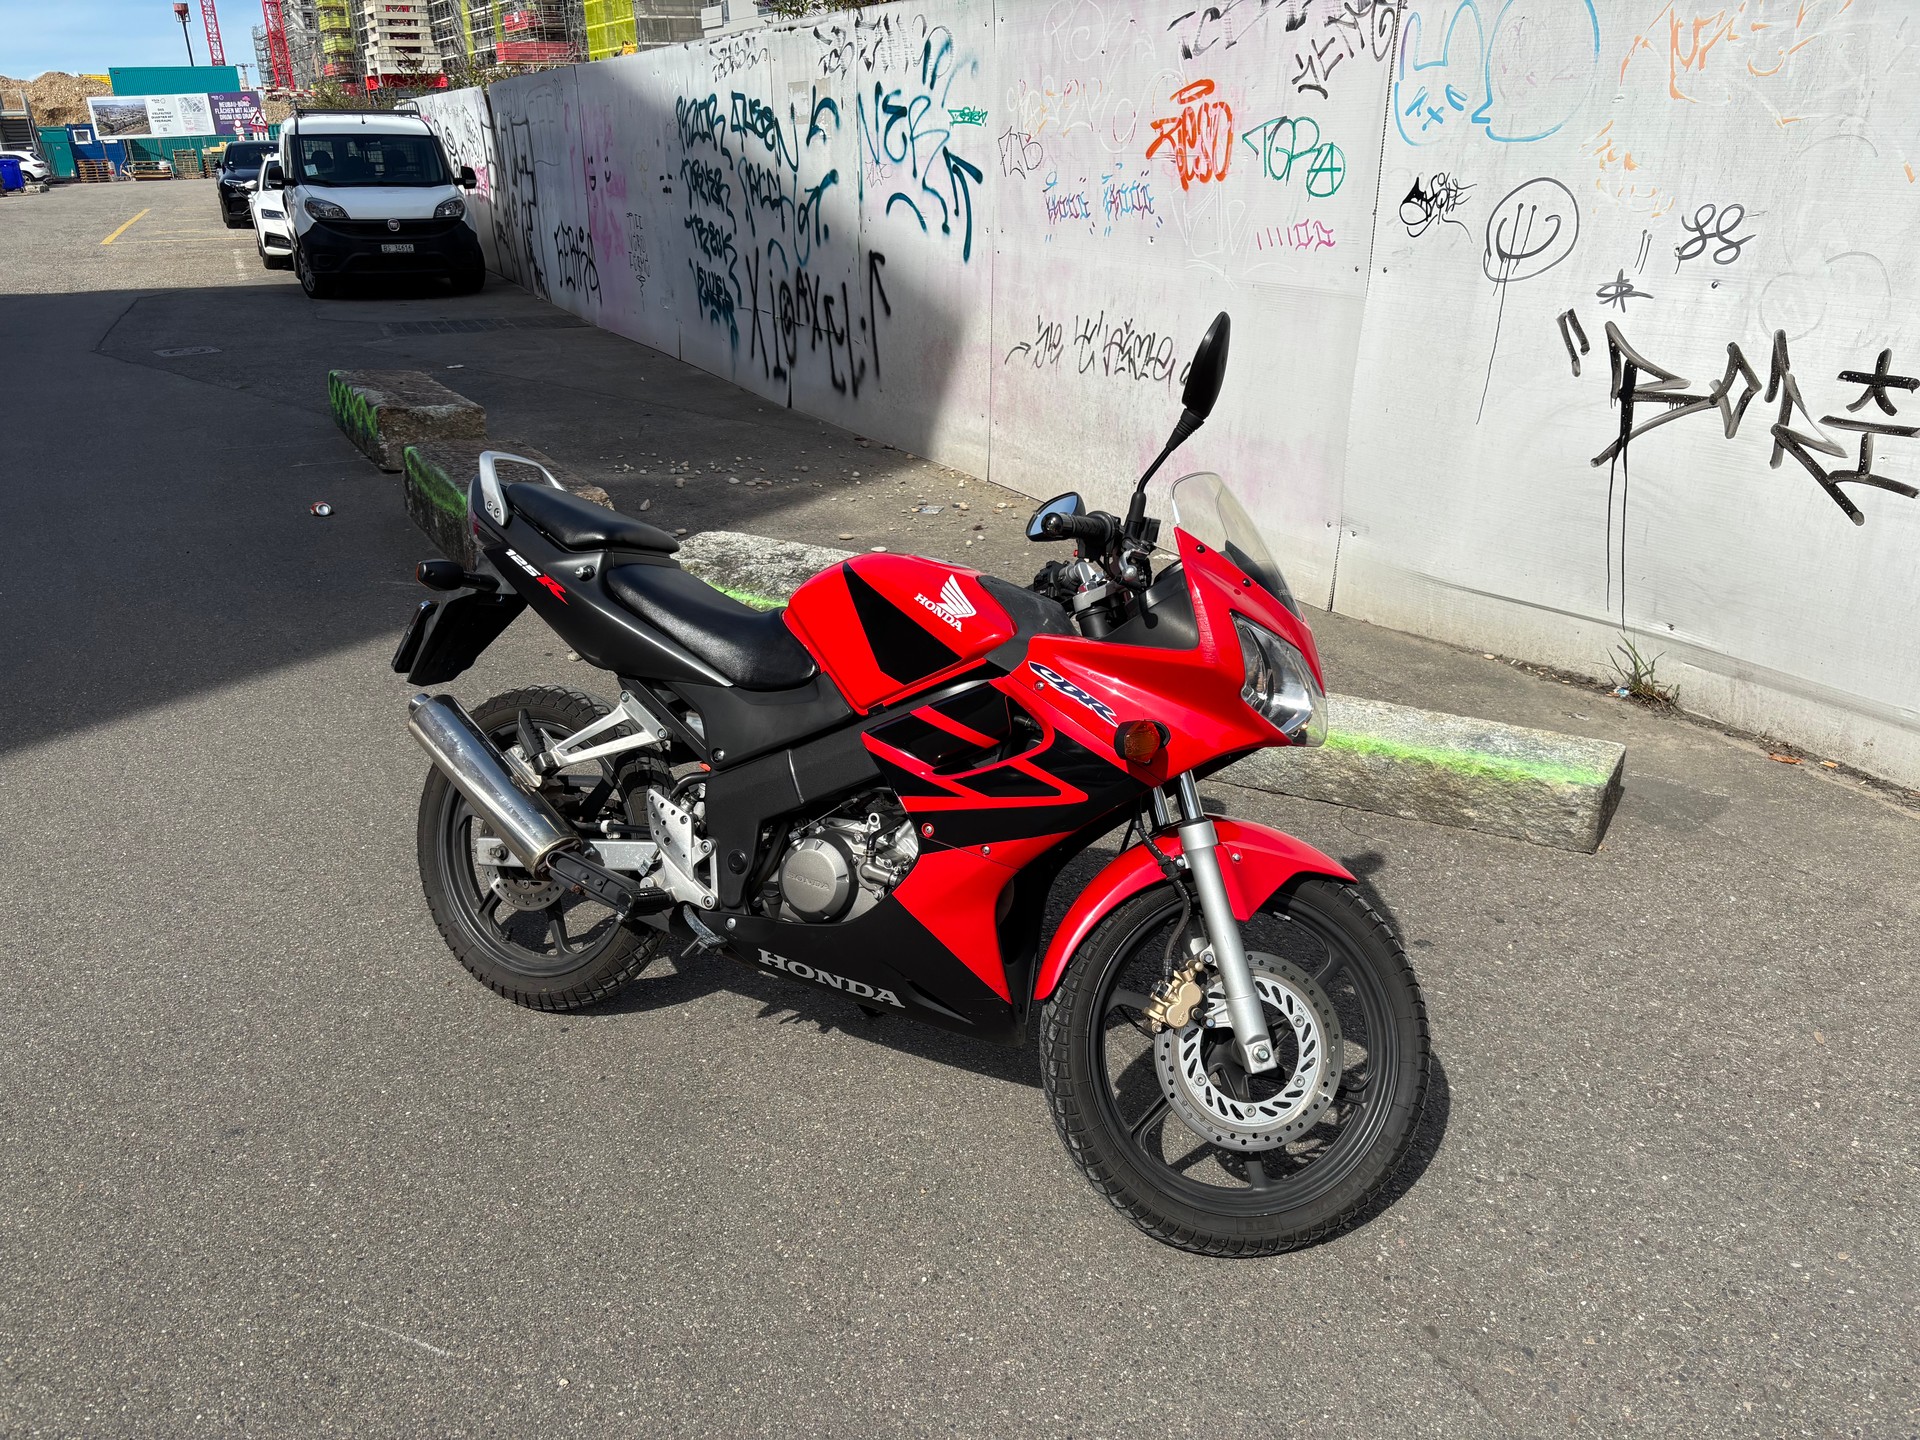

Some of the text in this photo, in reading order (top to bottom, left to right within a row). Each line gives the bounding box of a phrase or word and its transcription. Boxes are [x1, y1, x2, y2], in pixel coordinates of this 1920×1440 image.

[914, 592, 963, 633] HONDA
[786, 870, 831, 892] HONDA
[757, 948, 906, 1009] HONDA
